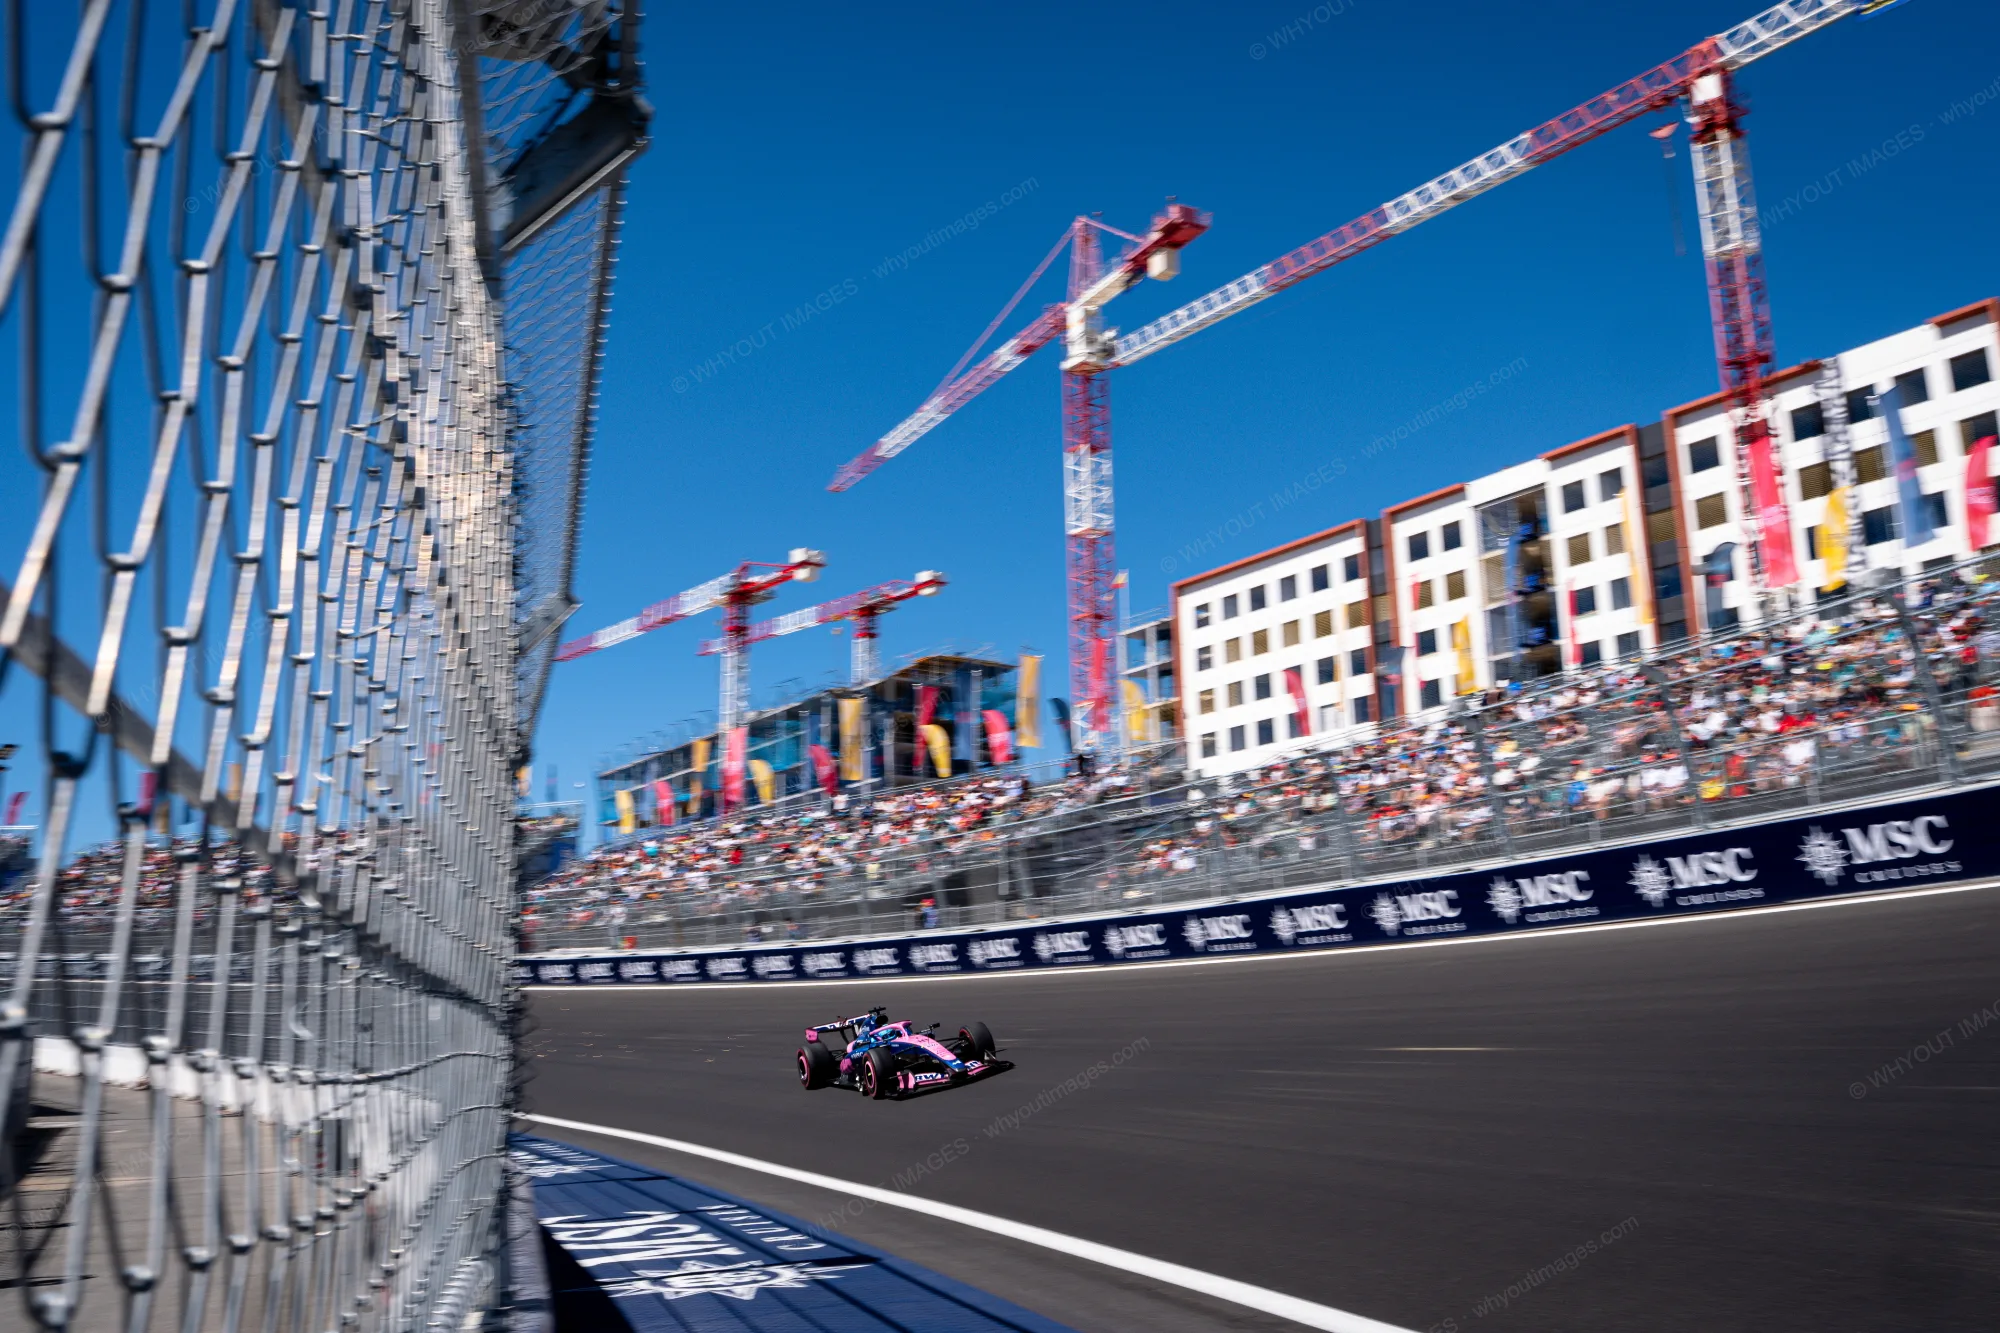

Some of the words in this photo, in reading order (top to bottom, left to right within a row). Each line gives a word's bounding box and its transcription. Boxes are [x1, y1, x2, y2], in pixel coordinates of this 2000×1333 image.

[1840, 815, 1954, 864] MSC
[1515, 871, 1594, 907] MSC
[1665, 848, 1758, 889] MSC
[1395, 890, 1462, 922] MSC
[538, 1211, 746, 1267] MSC
